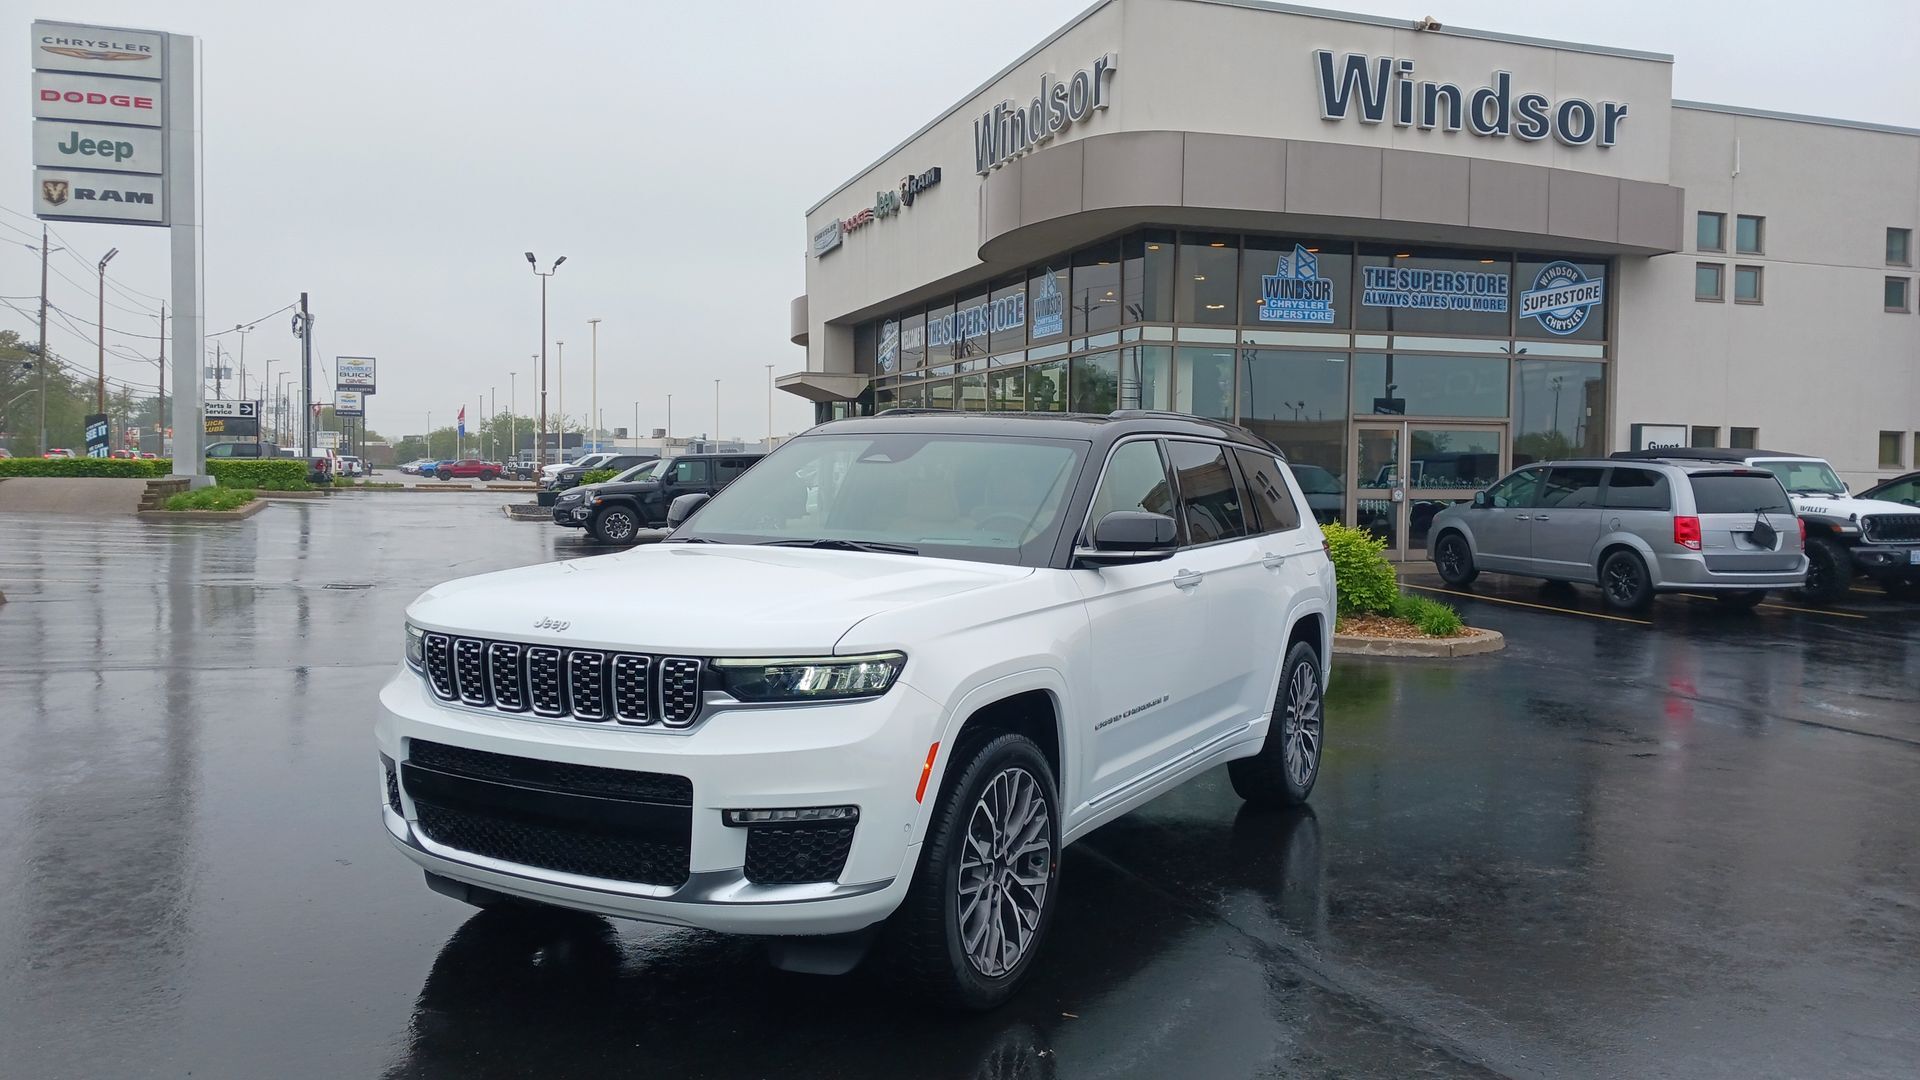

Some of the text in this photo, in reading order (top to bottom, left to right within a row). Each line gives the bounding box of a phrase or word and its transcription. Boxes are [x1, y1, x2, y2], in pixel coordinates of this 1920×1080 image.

[42, 36, 150, 53] CHRYSLER
[40, 89, 153, 109] DODGE
[1313, 49, 1629, 148] Windsor
[973, 52, 1118, 176] Windsor
[58, 131, 134, 162] Jeep
[909, 168, 940, 194] RAM
[74, 188, 153, 204] RAM
[873, 190, 899, 218] Jeep
[842, 208, 874, 233] DODGE
[1364, 267, 1508, 295] THE SUPERSTORE
[1540, 266, 1578, 286] WINDSOR
[1264, 278, 1331, 301] WINDSOR
[1523, 285, 1600, 311] SUPERSTORE
[1270, 300, 1324, 310] CHRYSLER
[1363, 290, 1508, 311] ALWAYS SAVES YOU MORE!
[928, 319, 942, 346] THE
[943, 293, 1025, 344] SUPERSTORE
[1262, 310, 1332, 320] SUPERSTORE
[1546, 309, 1584, 330] CHRYSLER
[86, 428, 98, 441] SEE
[98, 424, 107, 436] IT
[1800, 505, 1828, 514] WILLYS
[533, 616, 571, 633] Jeep
